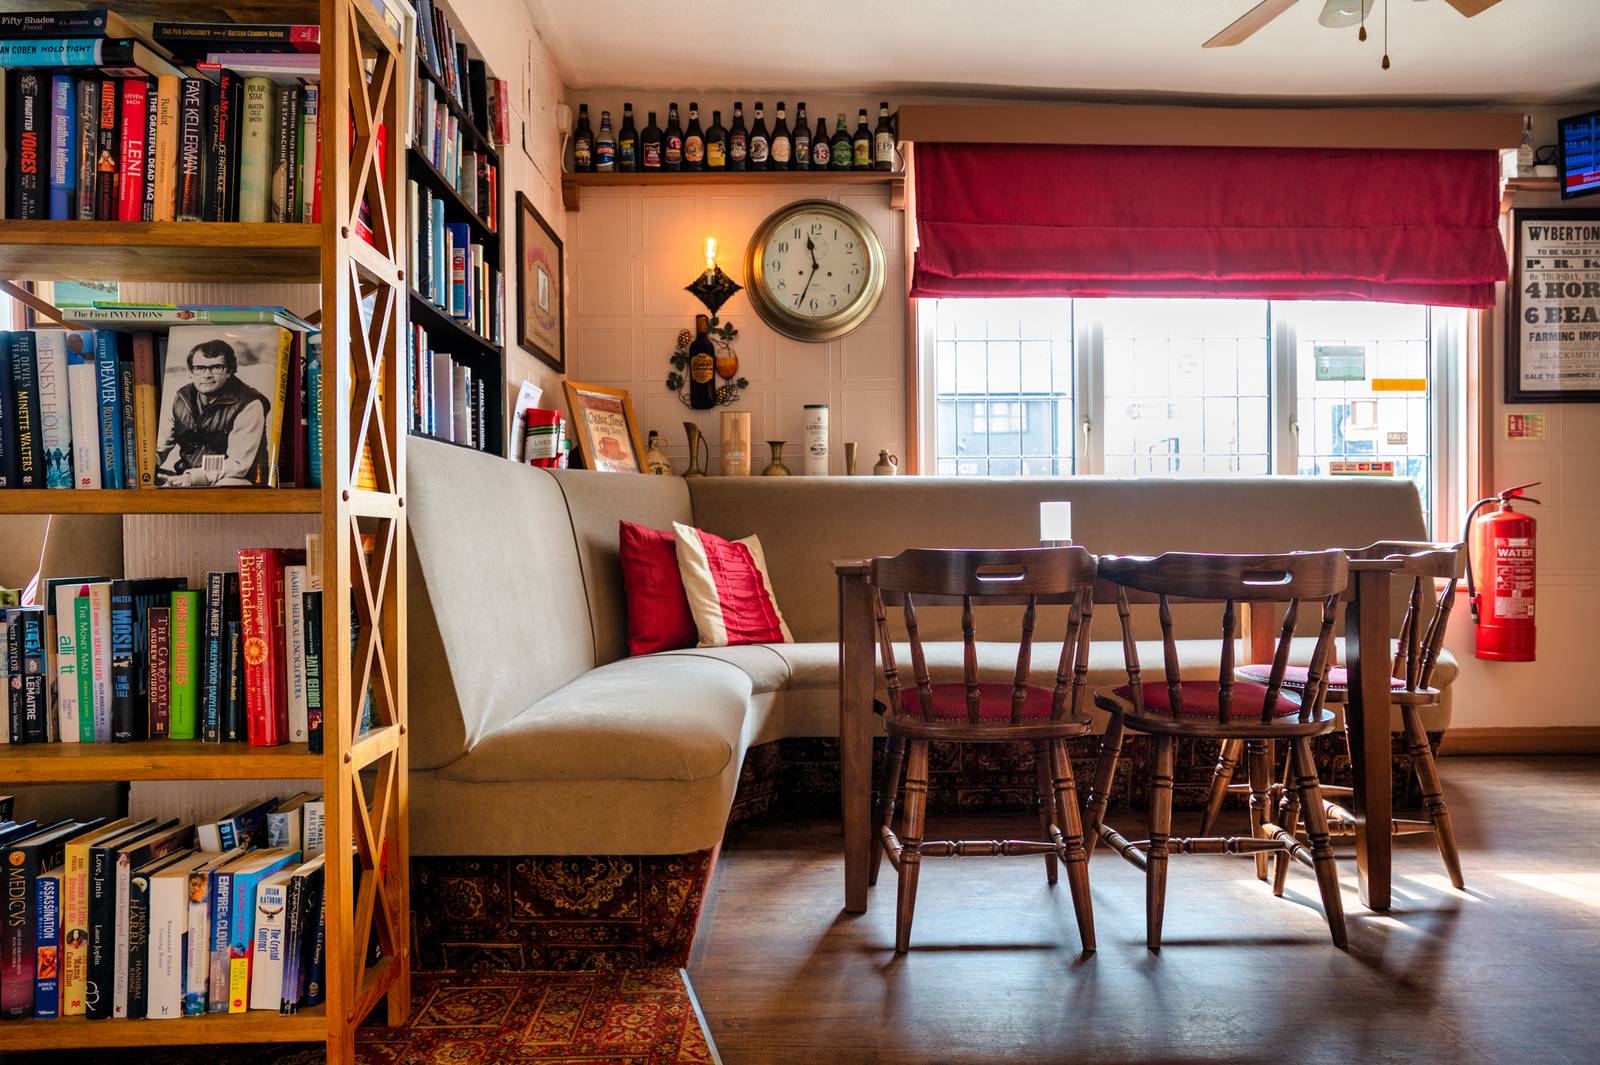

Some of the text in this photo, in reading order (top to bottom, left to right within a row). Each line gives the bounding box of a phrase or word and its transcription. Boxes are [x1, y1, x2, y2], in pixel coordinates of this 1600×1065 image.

[2, 16, 54, 26] Fifty Shades
[12, 46, 36, 54] COBEN
[185, 80, 200, 106] FAYE
[220, 76, 229, 90] Me
[248, 84, 266, 92] POLAR
[24, 96, 34, 131] FORGOTTEN
[80, 84, 95, 121] Somebody
[160, 98, 173, 126] Bardot
[218, 100, 229, 112] My
[55, 82, 70, 184] therapy jonathan kellerman
[148, 114, 156, 156] GRATEFUL
[183, 108, 199, 175] KELLERMAN
[220, 113, 228, 142] Camera
[128, 139, 142, 177] LENI
[218, 142, 226, 156] JOE
[216, 156, 226, 193] PARTRIDGE
[794, 228, 800, 240] 11
[811, 224, 822, 236] 12
[834, 229, 838, 240] 1
[1528, 226, 1600, 240] WYBERTON
[778, 242, 788, 253] 10
[772, 260, 780, 272] 9
[778, 279, 786, 289] 8
[792, 294, 800, 306] 7
[829, 294, 837, 306] 5
[1525, 282, 1540, 298] 4
[72, 310, 163, 320] The First INVENTIONS
[810, 298, 818, 310] 6
[1525, 307, 1539, 324] 6
[1529, 332, 1575, 342] FARMING
[12, 344, 20, 380] FEATHER
[19, 336, 31, 387] THE DEVIL'S
[38, 348, 56, 400] FINEST
[98, 338, 116, 404] JEFFERY DEAVER
[123, 370, 134, 420] Calendar Girl
[280, 370, 288, 402] SMITH
[16, 391, 32, 471] MINETTE WALTERS
[42, 403, 58, 448] HOUR
[608, 414, 624, 427] Time
[103, 406, 114, 471] ROADSIDE CROSSES
[1498, 548, 1533, 557] WATER
[211, 576, 220, 606] KENNETH
[239, 555, 256, 635] Birthdays
[255, 555, 266, 634] The Secret Language of
[176, 596, 189, 621] ISMS
[210, 608, 220, 636] ANGER'S
[292, 602, 300, 638] MEDICAL
[9, 615, 17, 640] Roberta
[25, 620, 40, 656] ALEX
[79, 605, 89, 675] THE MONEY MAZE
[112, 610, 132, 668] MOSLEY
[177, 624, 186, 639] AND
[157, 616, 168, 718] THE GARGOYLE
[176, 640, 188, 684] OLOGIES
[209, 640, 218, 684] HOLLYWOOD
[292, 640, 302, 700] ENCYCLOPEDIA
[306, 654, 318, 676] ALIVE
[26, 676, 36, 720] LEMAITRE
[208, 686, 217, 718] BABYLON
[307, 678, 320, 707] BURIED
[307, 810, 317, 851] MARSHALL
[68, 877, 78, 902] Dream
[94, 854, 104, 898] Love, Janis
[265, 887, 280, 896] JULIAN
[8, 868, 26, 926] MEDICVS
[43, 880, 54, 939] ASSASSINATION
[78, 874, 87, 926] Dream Little
[117, 874, 126, 937] Childhood Interrupted
[216, 876, 230, 912] EMPIRE
[68, 913, 78, 923] Me
[128, 898, 138, 952] HARRIS
[138, 906, 147, 945] THOMAS
[92, 924, 102, 965] Laura Joplin
[116, 943, 125, 968] Kathleen
[257, 927, 268, 952] Contract
[268, 929, 282, 960] The Crystal
[65, 951, 74, 988] Cass Elliot
[134, 960, 142, 1000] HANNIBAL
[232, 967, 240, 992] GAYLE
